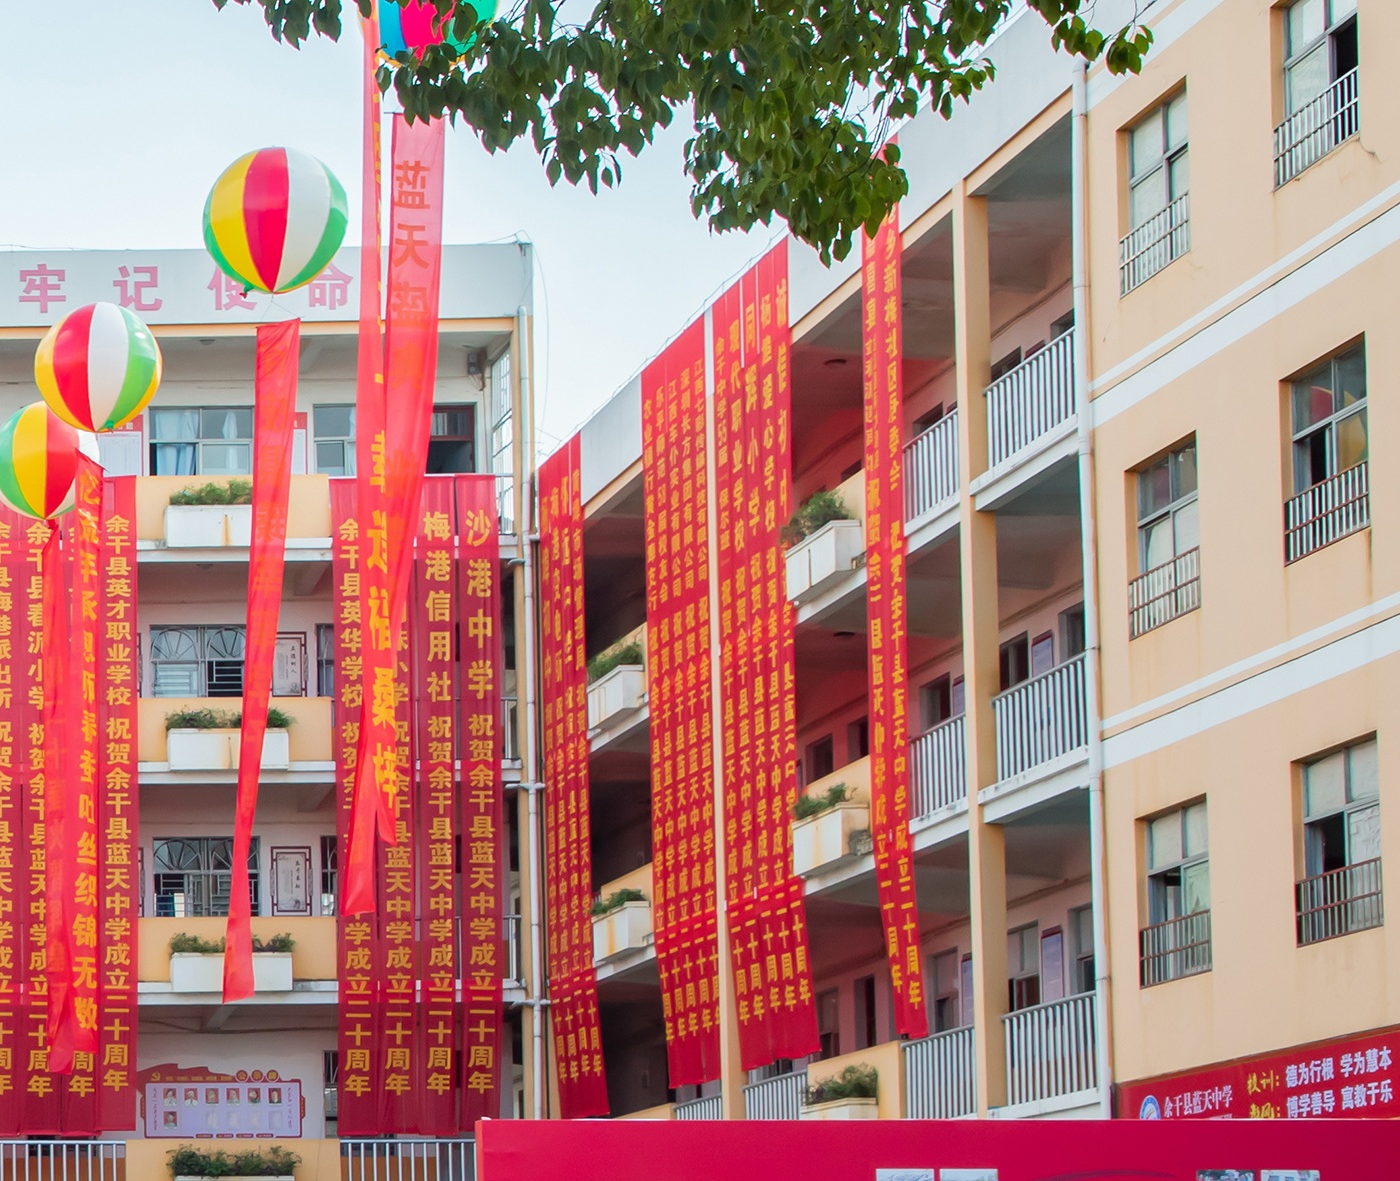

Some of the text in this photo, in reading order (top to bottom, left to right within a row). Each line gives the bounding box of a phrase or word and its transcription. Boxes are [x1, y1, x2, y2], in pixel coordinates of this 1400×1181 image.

[18, 262, 355, 313] 牢记使命
[338, 518, 363, 708] 余干县英华学校
[103, 515, 132, 1092] 余干县英才职业学校 祝贺余干县蓝天中学成立二十周年
[423, 511, 452, 1095] 梅港信用社 祝贺余干县蓝天中学成立二十周年
[465, 509, 496, 1094] 沙港中学 祝贺余干县蓝天中学成立二十周年
[1163, 1085, 1233, 1118] 余干县蓝天中学
[1285, 1057, 1335, 1088] 德为行根
[1340, 1045, 1393, 1079] 学为慧本
[1286, 1079, 1394, 1119] 博学善导 寓教于乐
